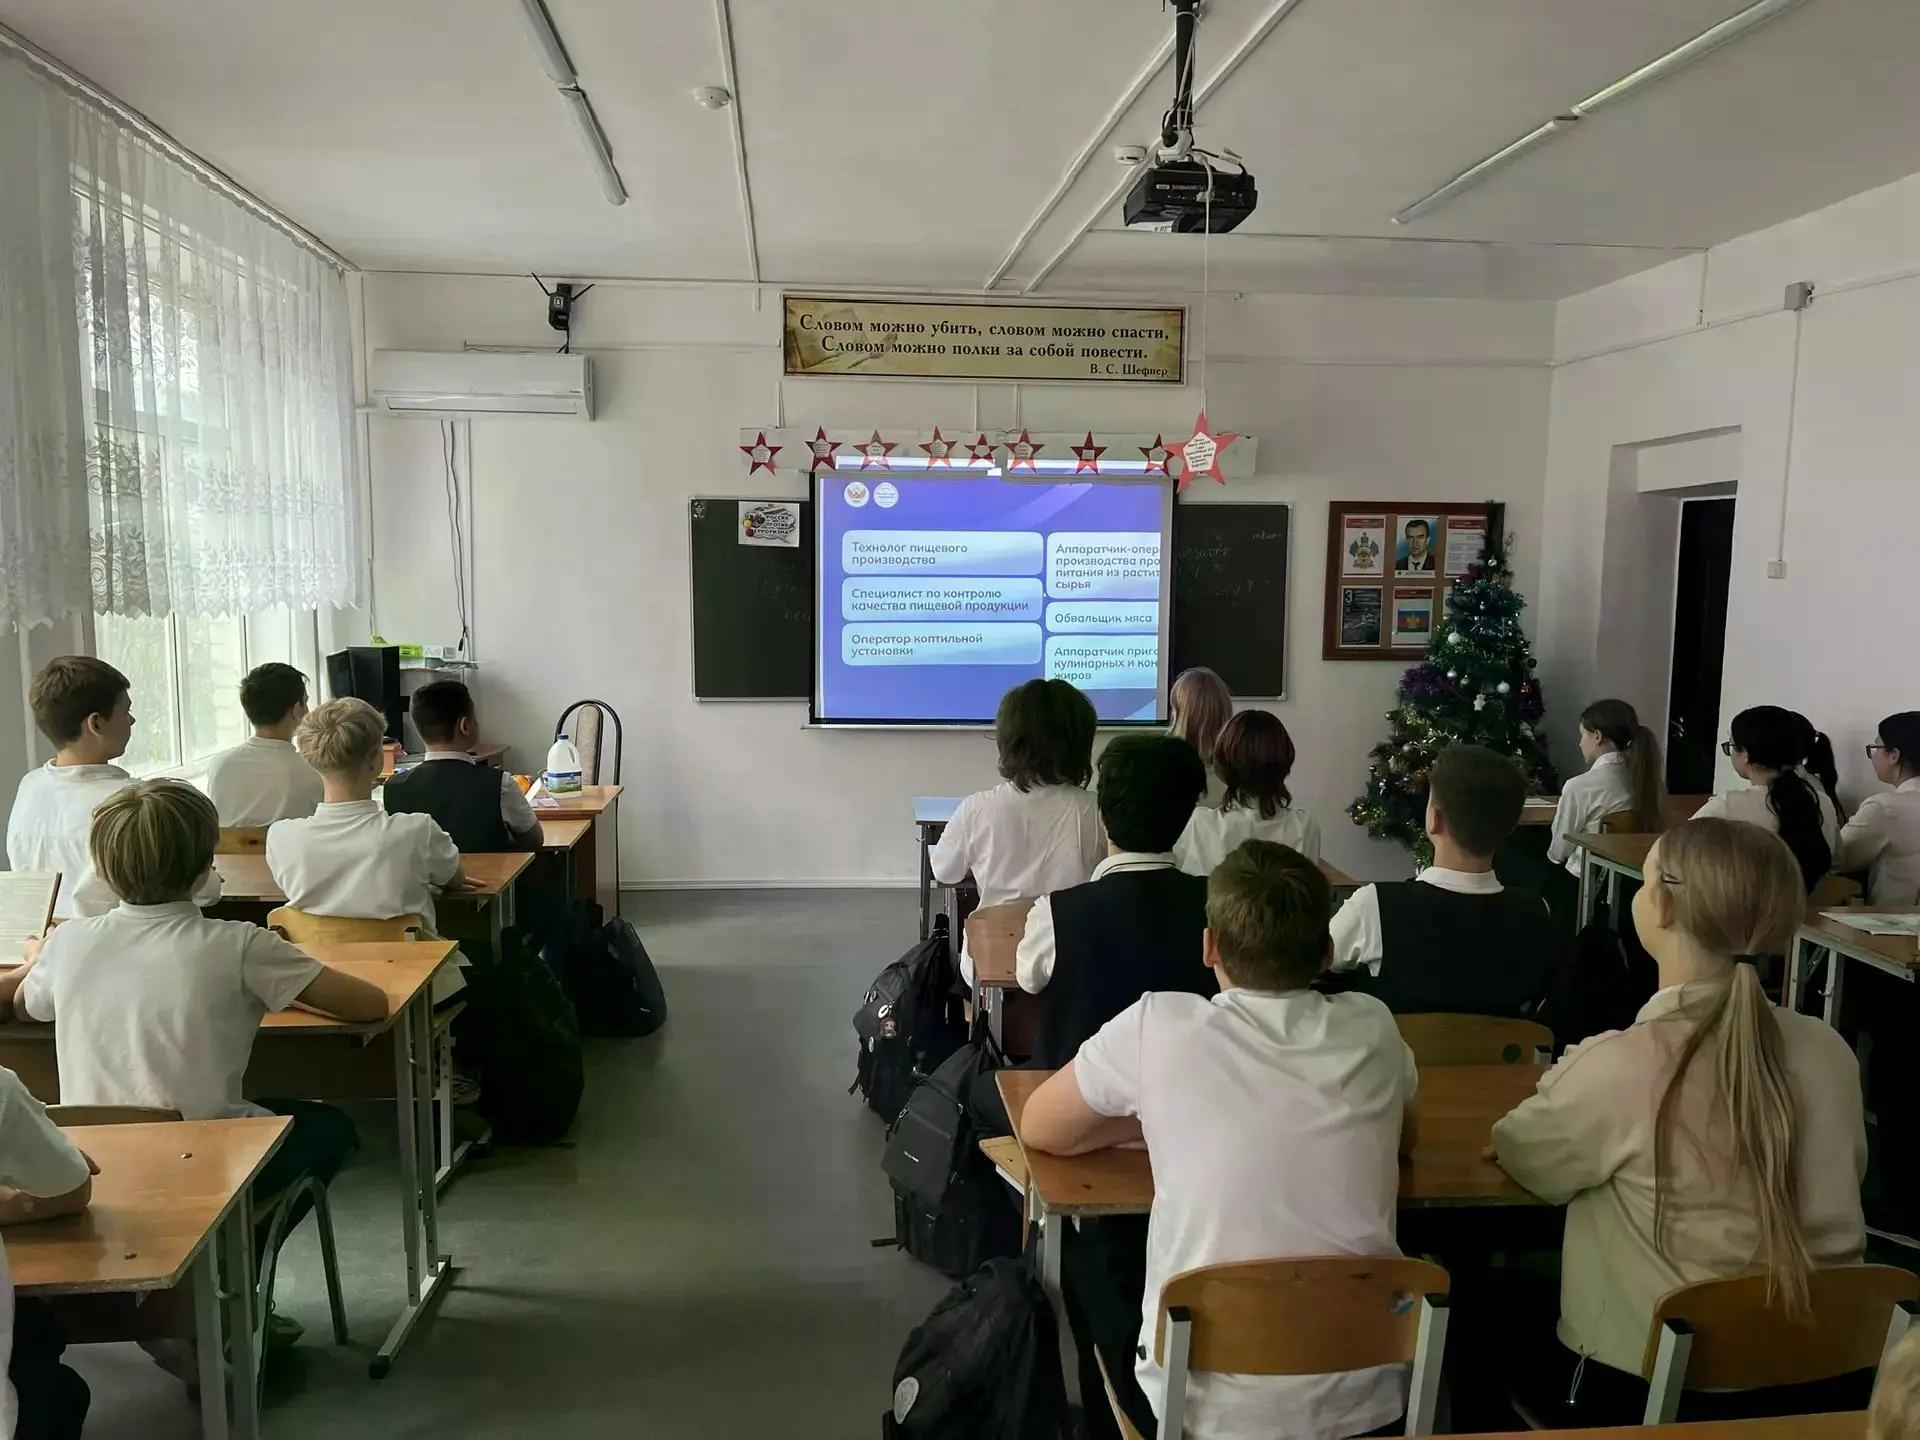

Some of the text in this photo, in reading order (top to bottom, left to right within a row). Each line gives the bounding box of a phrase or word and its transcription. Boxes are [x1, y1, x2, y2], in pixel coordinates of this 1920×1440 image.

[799, 314, 1169, 341] Словом можно убить, словом можно спасти,
[821, 335, 1148, 359] Словом можно полки за собой повести.
[1090, 363, 1102, 375] В.
[1106, 363, 1118, 375] С.
[852, 541, 968, 554] Технолог пищевого
[852, 556, 936, 566] производства
[1056, 558, 1136, 568] производства
[1056, 569, 1104, 578] питания
[1107, 569, 1120, 577] из
[1056, 581, 1091, 591] сырья
[851, 588, 1002, 600] Специалист по контролю
[851, 600, 1029, 613] качества пищевой продукции
[1055, 613, 1152, 624] Обвальщик мяса
[851, 633, 983, 646] Оператор коптильной
[851, 647, 913, 658] установки
[1054, 647, 1124, 658] Аппаратчик
[1054, 660, 1125, 670] кулинарных
[1127, 660, 1135, 668] и
[1054, 672, 1092, 682] жиров
